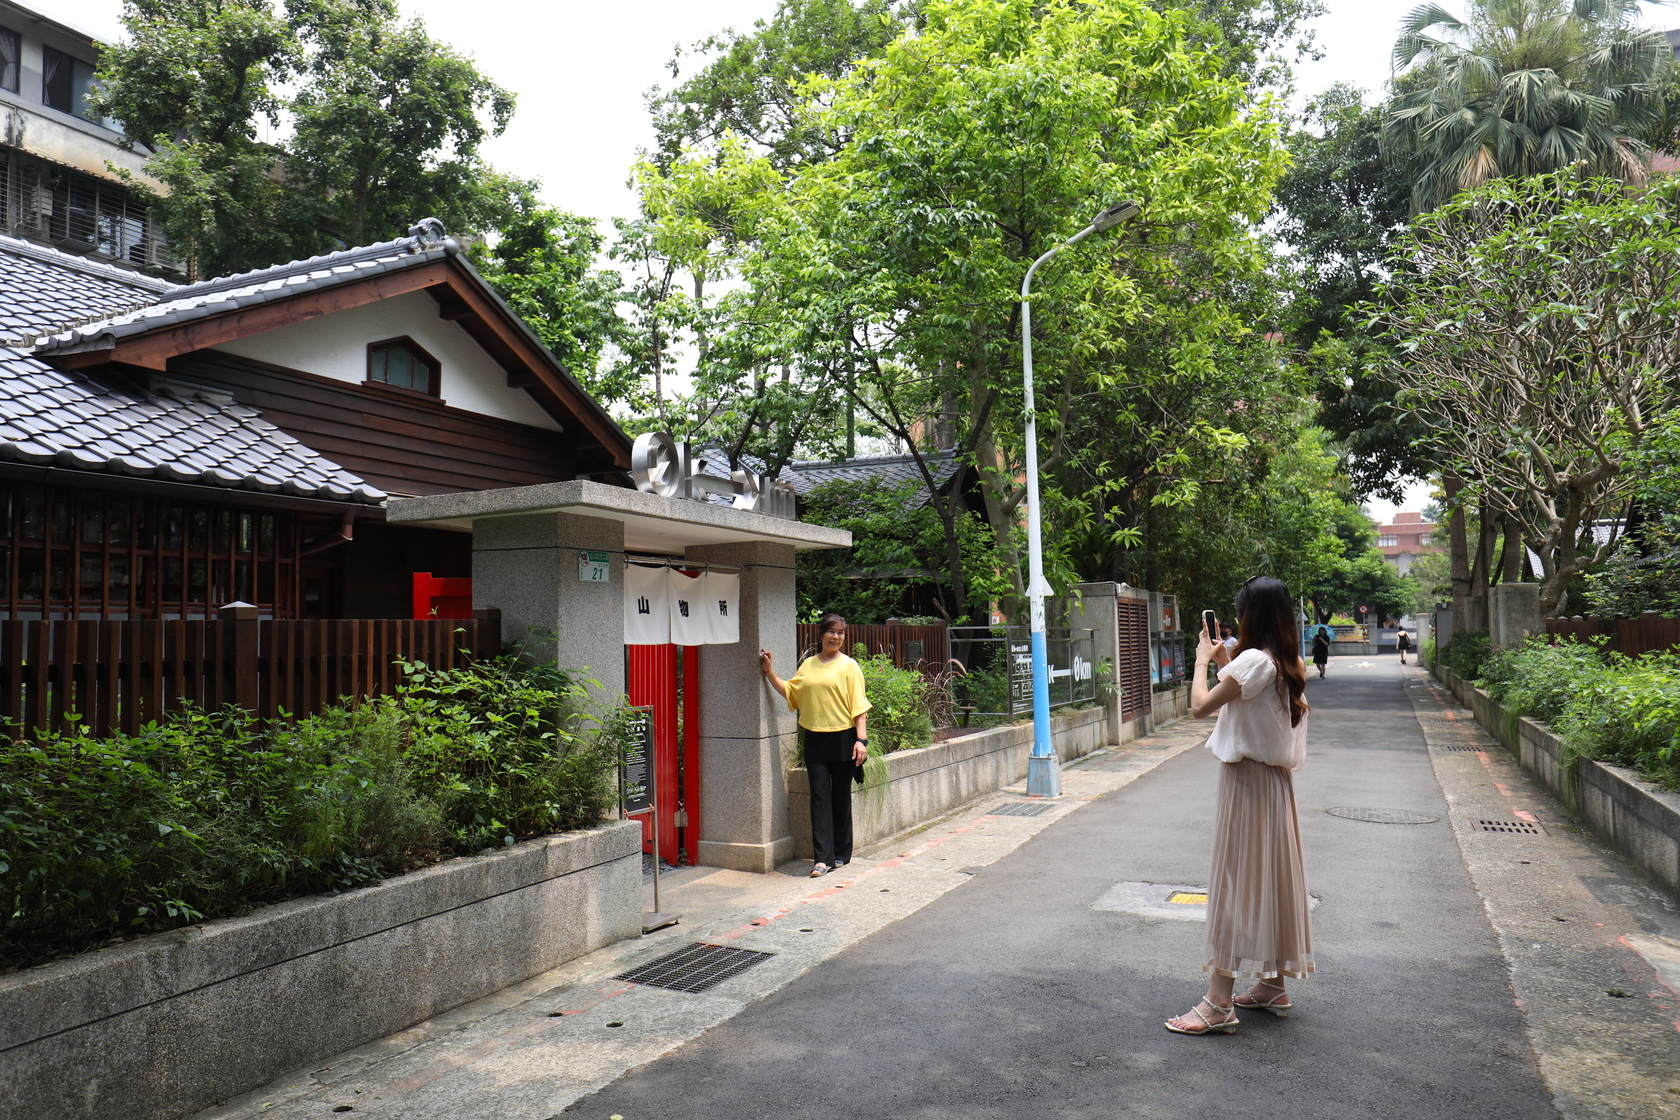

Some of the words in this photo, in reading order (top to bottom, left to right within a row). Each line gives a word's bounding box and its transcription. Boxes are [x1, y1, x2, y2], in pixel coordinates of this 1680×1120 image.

[592, 567, 603, 580] 21
[637, 595, 729, 618] 山物所
